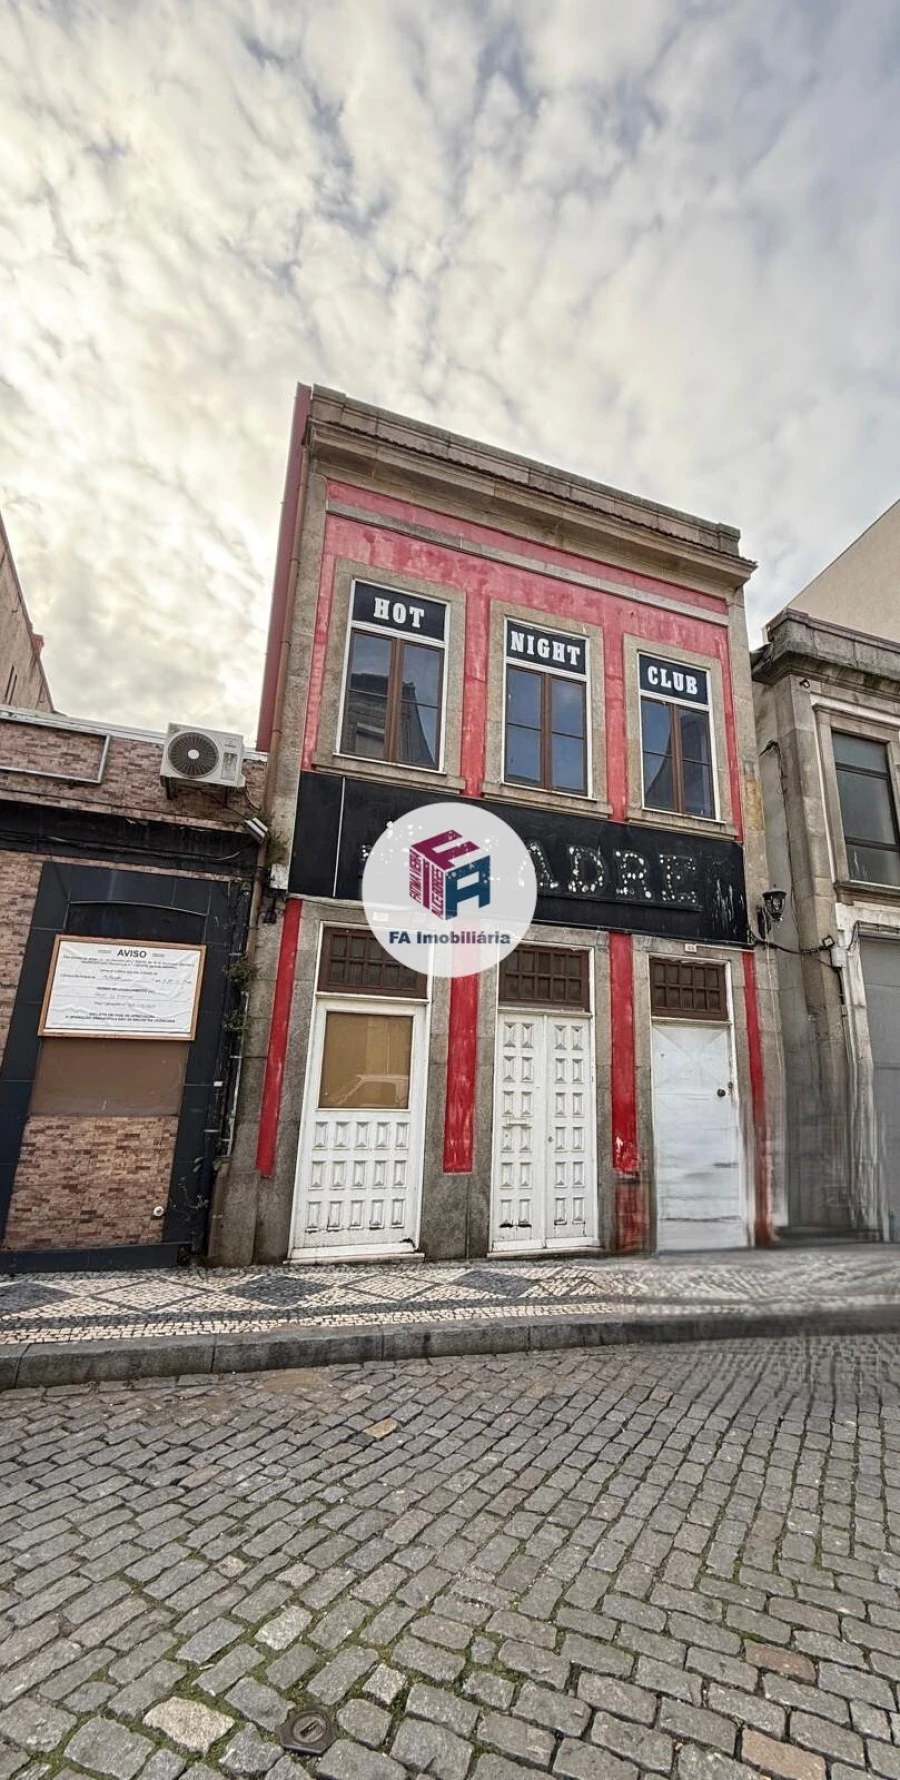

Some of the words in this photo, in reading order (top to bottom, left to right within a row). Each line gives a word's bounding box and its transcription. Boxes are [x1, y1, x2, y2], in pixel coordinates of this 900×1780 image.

[374, 597, 425, 628] HOT
[510, 630, 580, 666] NIGHT
[647, 665, 698, 695] CLUB
[483, 838, 698, 904] ADRE
[117, 949, 147, 959] AVISO
